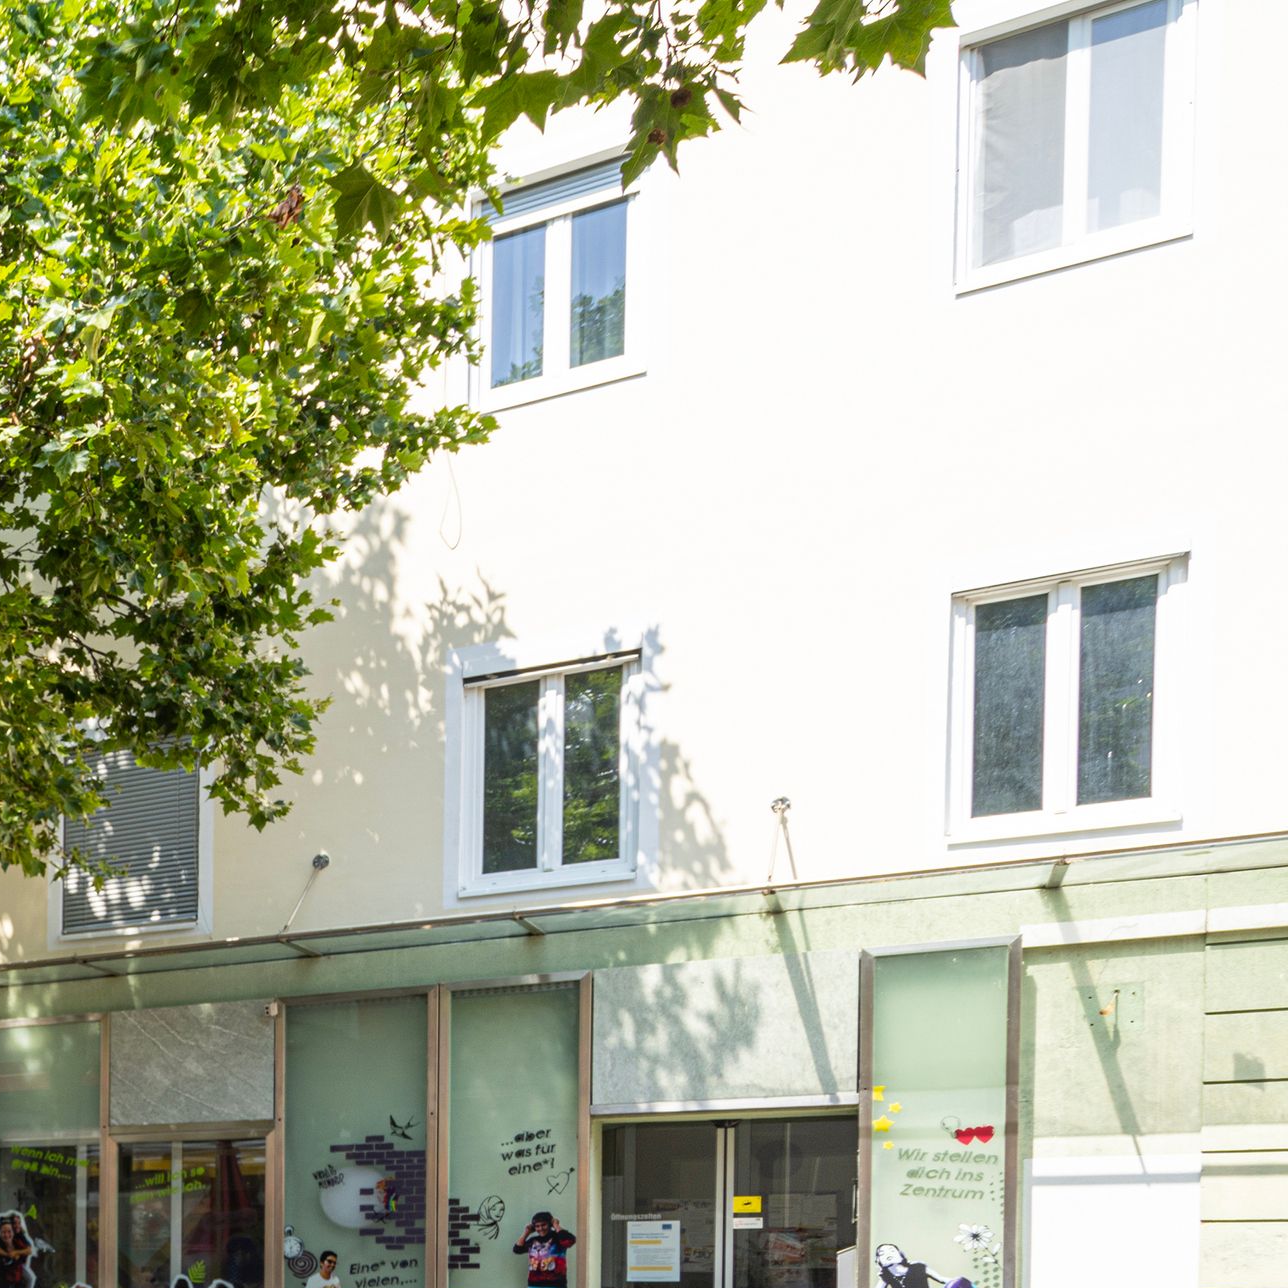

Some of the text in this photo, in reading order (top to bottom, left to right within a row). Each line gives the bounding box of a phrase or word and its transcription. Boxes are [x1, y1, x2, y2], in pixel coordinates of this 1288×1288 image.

[501, 1147, 532, 1162] was
[898, 1147, 999, 1164] Wir stellen
[906, 1167, 984, 1182] dich ins
[899, 1183, 985, 1200] Zentrum
[611, 1212, 662, 1221] Öffnungszeiten
[391, 1258, 419, 1270] von
